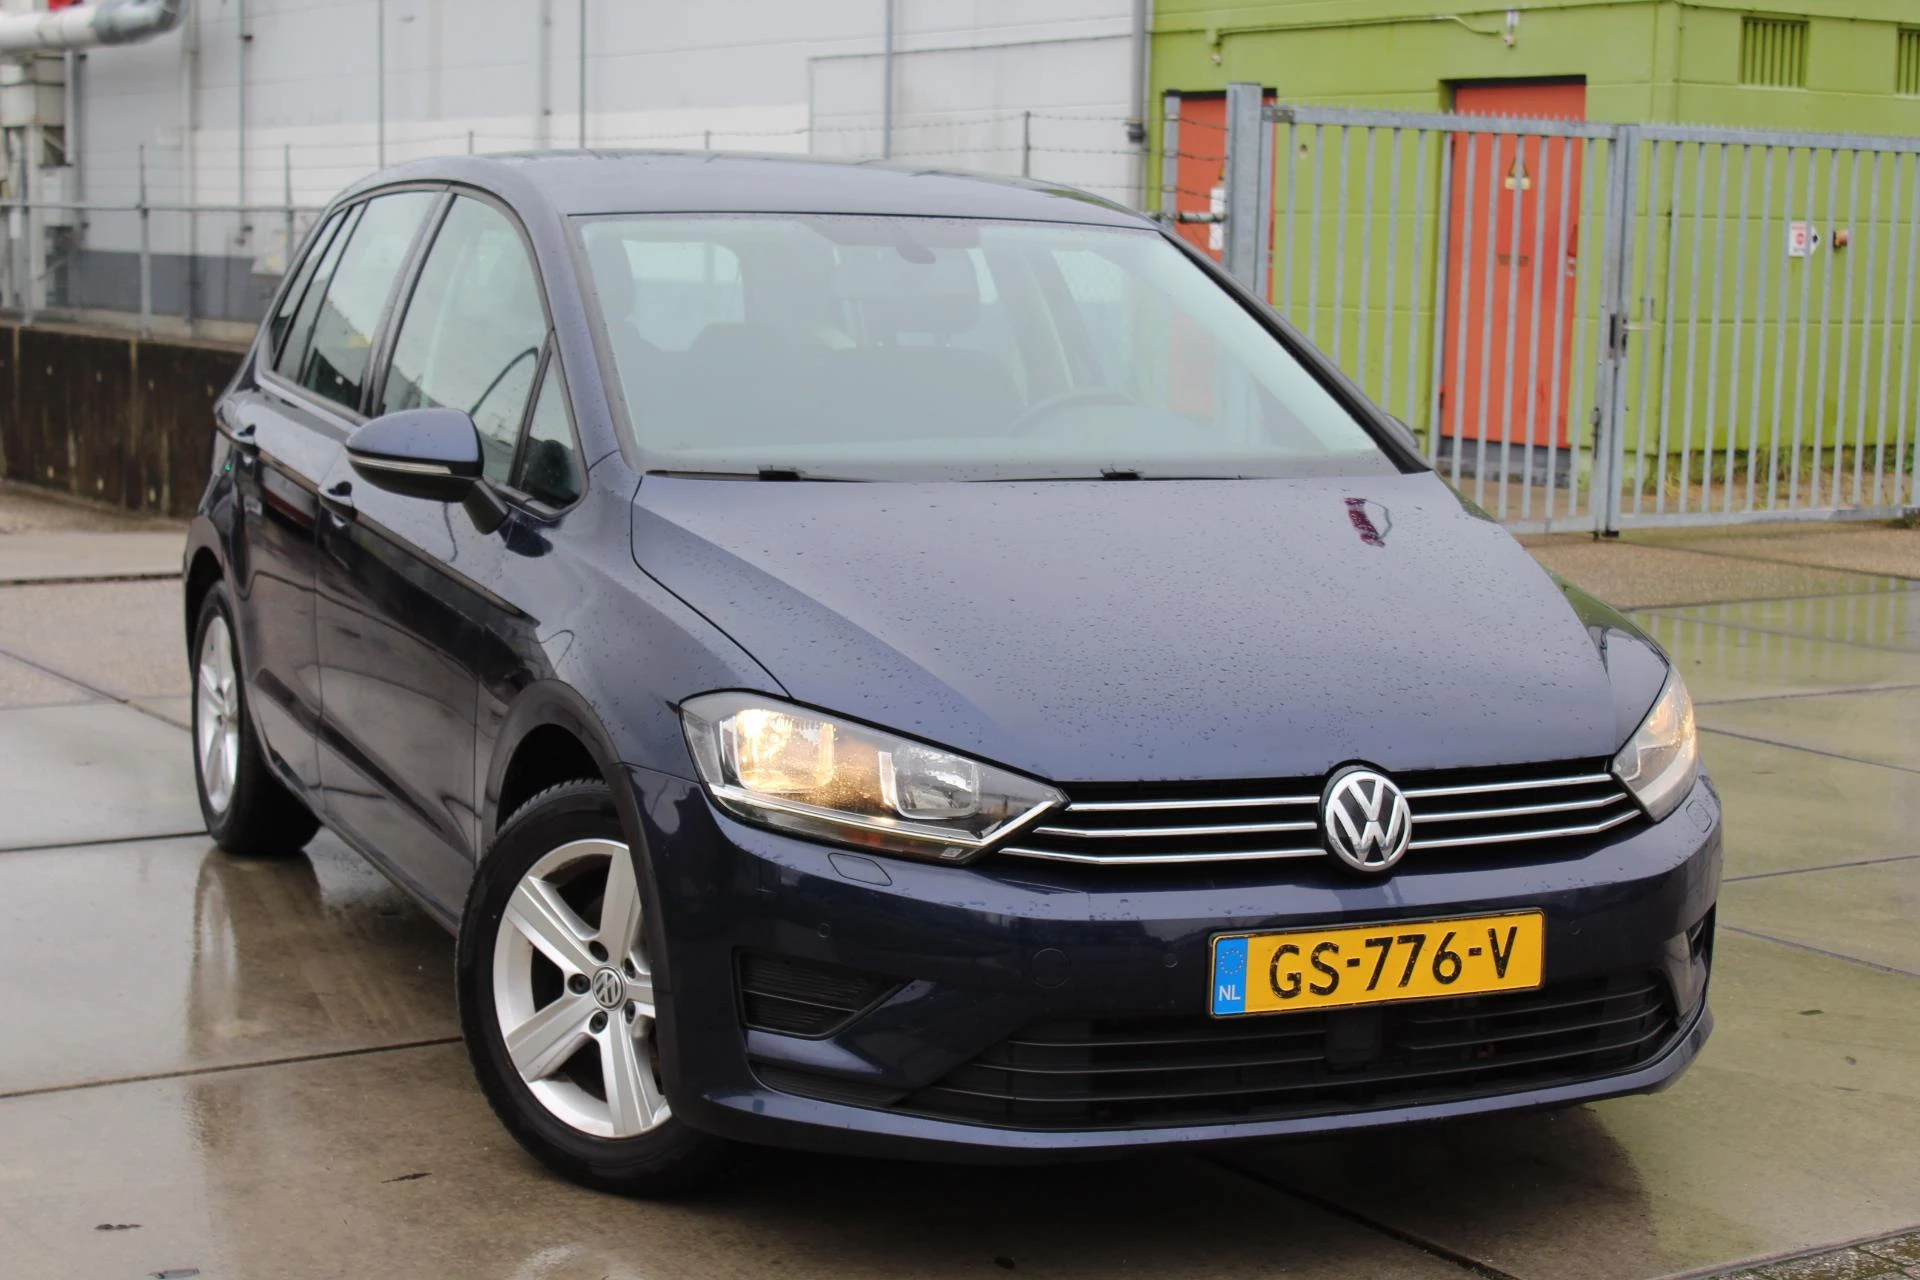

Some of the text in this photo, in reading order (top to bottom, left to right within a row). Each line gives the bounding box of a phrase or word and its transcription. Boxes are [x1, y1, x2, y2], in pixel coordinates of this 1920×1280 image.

[1329, 773, 1408, 867] VW
[1218, 985, 1241, 1001] NL
[1269, 926, 1518, 999] GS-776-V
